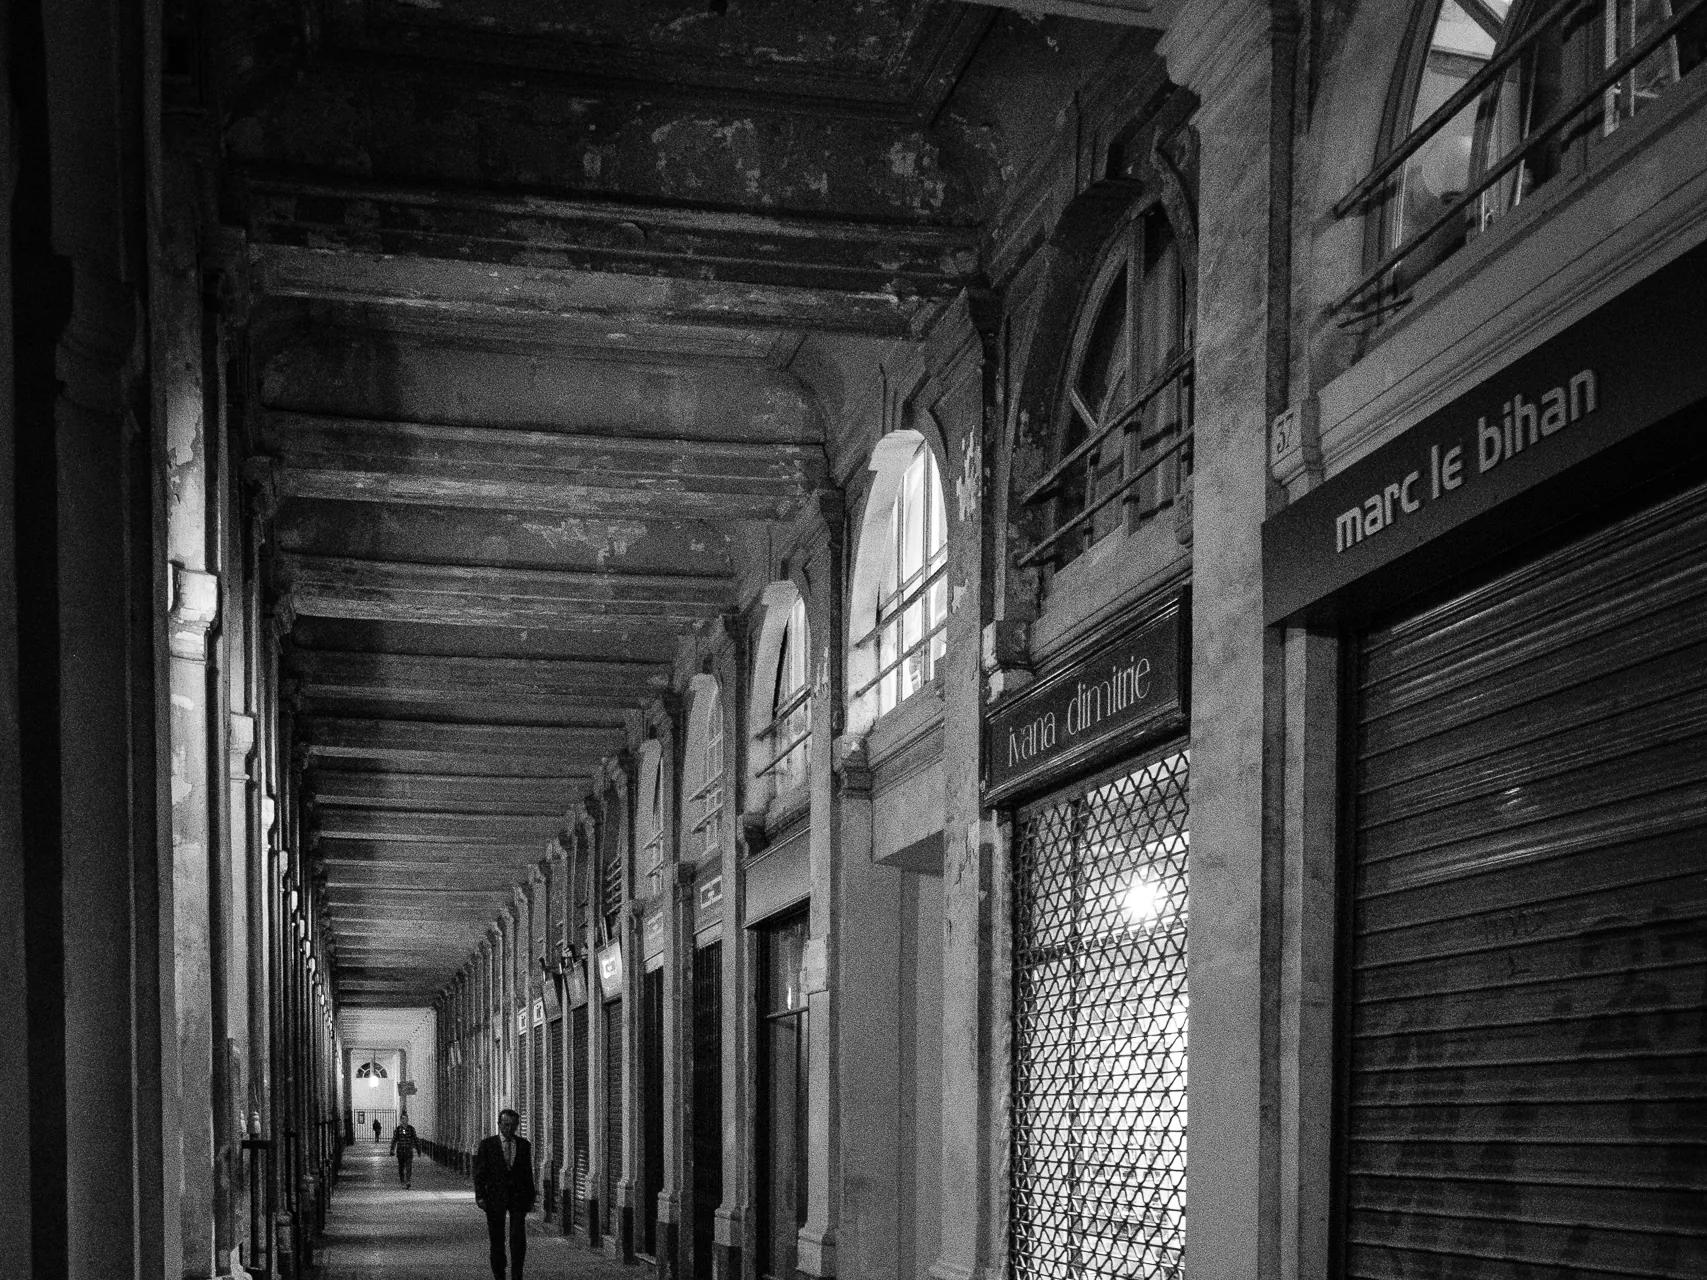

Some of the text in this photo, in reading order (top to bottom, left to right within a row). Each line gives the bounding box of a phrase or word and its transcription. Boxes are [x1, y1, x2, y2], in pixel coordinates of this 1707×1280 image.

[1277, 412, 1294, 453] 37
[1335, 368, 1599, 553] marc le bihan
[1009, 656, 1151, 767] ivana dimitrie
